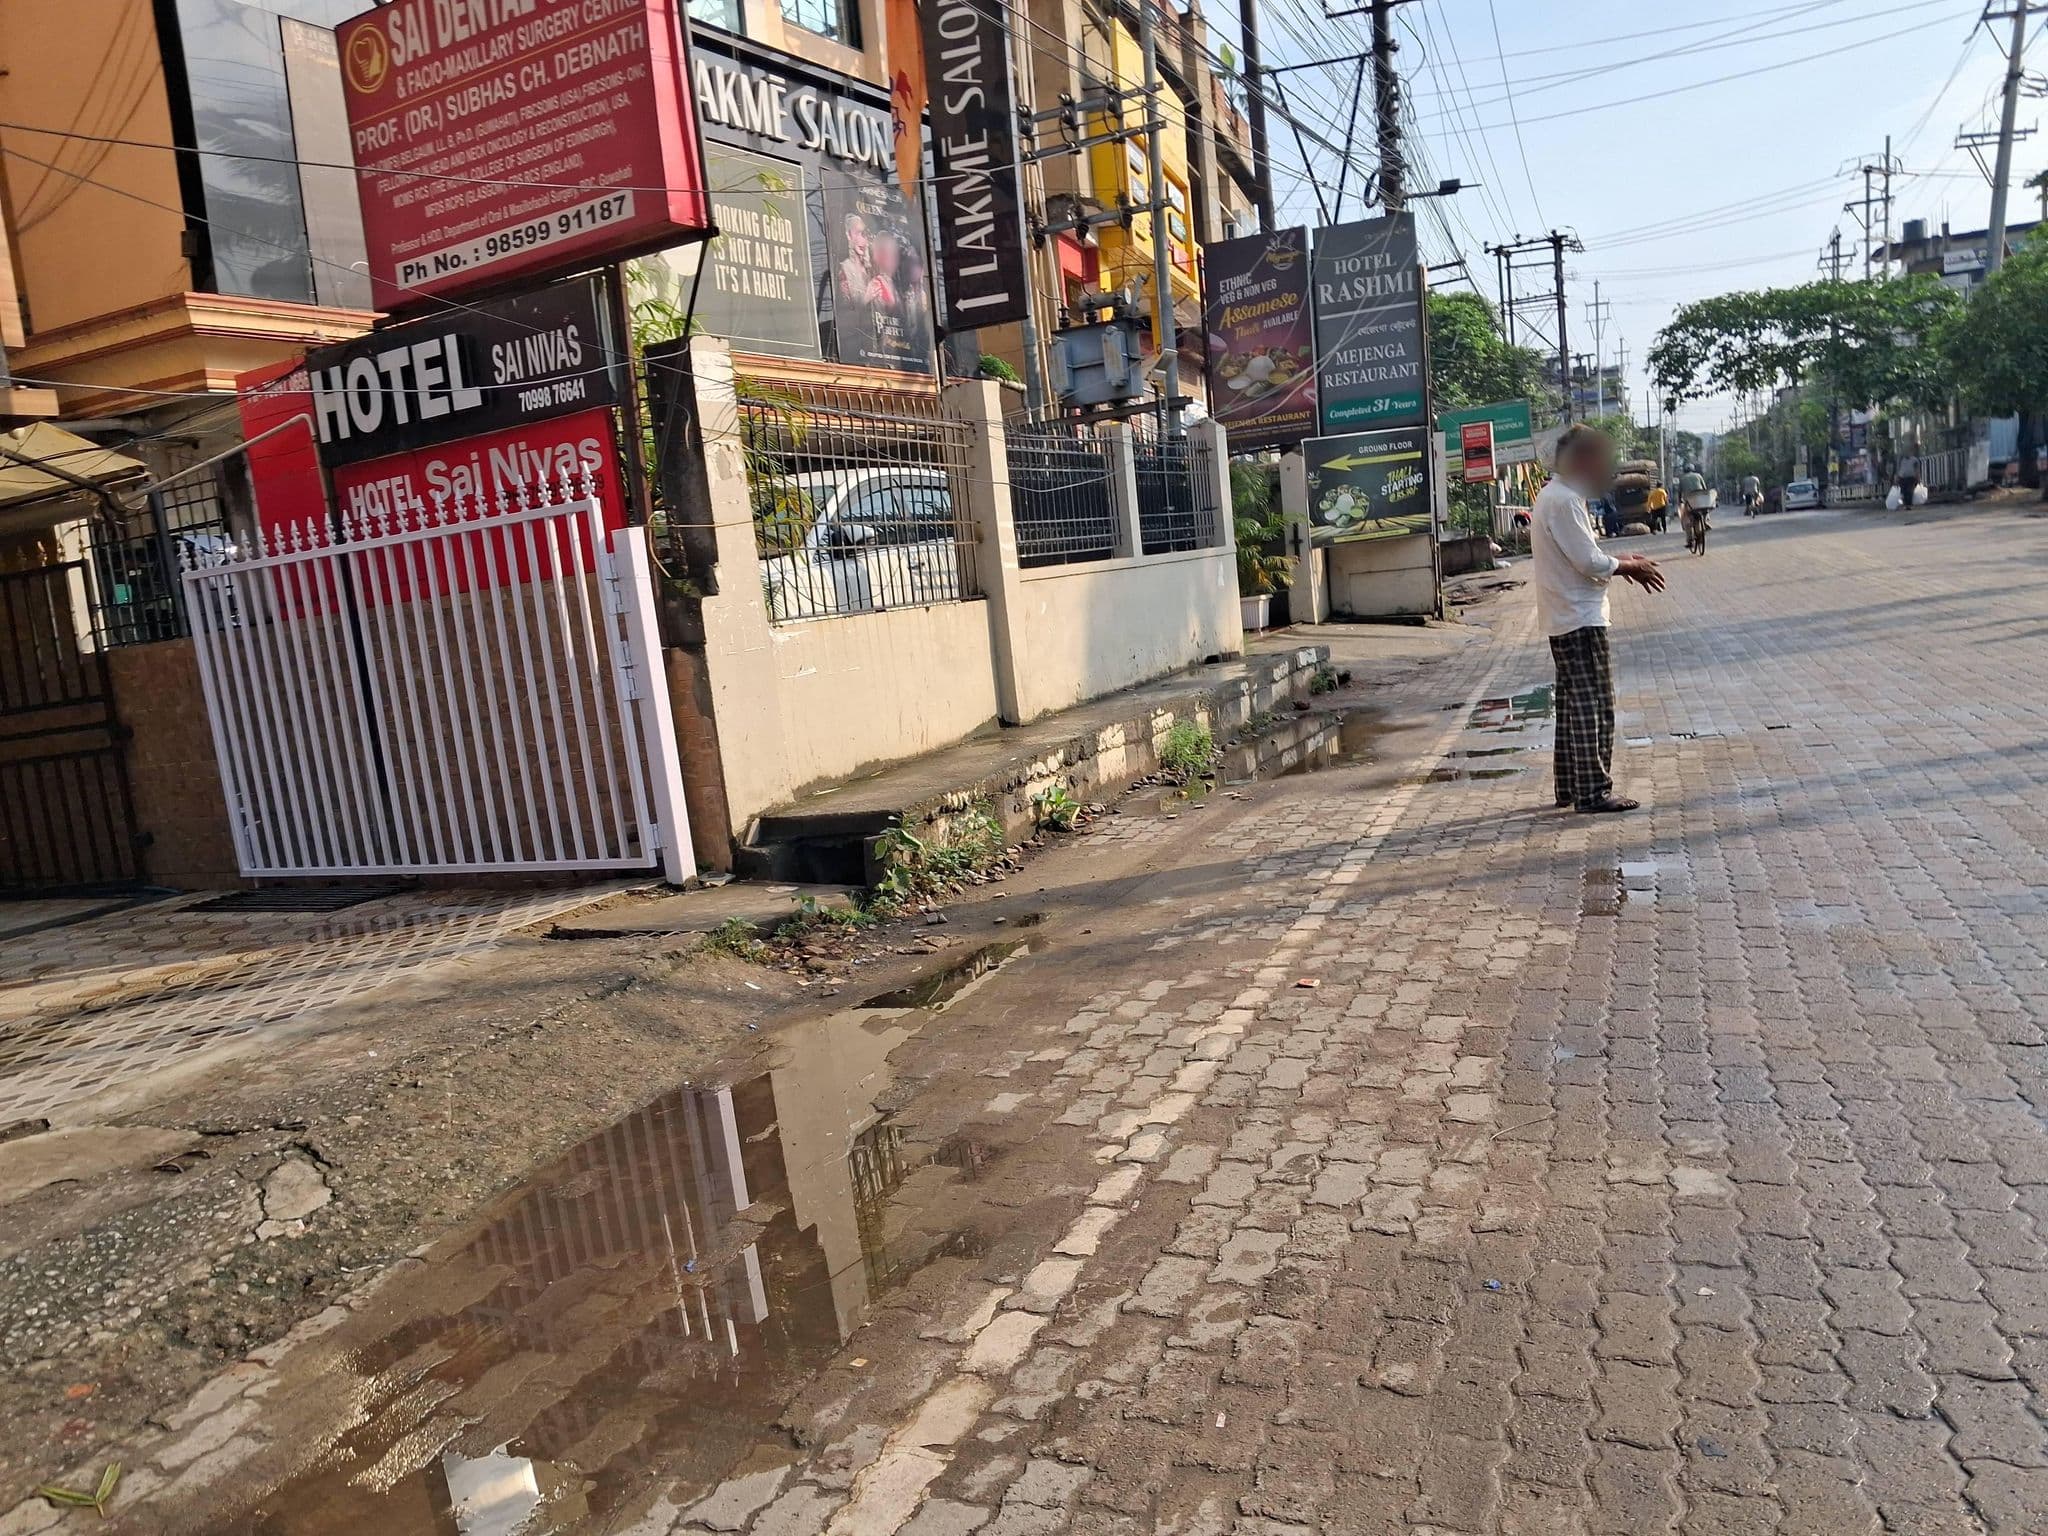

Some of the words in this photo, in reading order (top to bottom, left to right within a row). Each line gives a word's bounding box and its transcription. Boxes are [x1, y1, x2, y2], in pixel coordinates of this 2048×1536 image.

[388, 0, 430, 66] SAI
[396, 76, 407, 98] &
[407, 30, 514, 95] FACIO-MAXILLARY
[517, 4, 579, 50] SURGERY
[356, 114, 402, 154] PROF.
[403, 98, 444, 143] (DR.)
[445, 70, 517, 121] SUBHAS
[518, 57, 551, 93] CH.
[554, 21, 645, 80] DEBNATH
[800, 94, 890, 169] SALON
[429, 156, 449, 176] HEAD
[449, 150, 465, 168] AND
[465, 143, 486, 163] NECK
[485, 127, 528, 155] ONCOLOGY
[468, 157, 504, 183] COLLEGE
[504, 153, 517, 170] OF
[516, 140, 553, 166] SURGEON
[553, 136, 565, 153] OF
[402, 259, 427, 284] Ph
[433, 246, 467, 274] No.
[472, 242, 480, 261] :
[485, 219, 550, 257] 98599
[557, 195, 627, 235] 91187
[443, 215, 480, 238] Department
[762, 214, 793, 244] GOOD
[714, 236, 725, 261] IS
[728, 237, 751, 264] NOT
[755, 242, 771, 268] AN
[1334, 253, 1397, 275] HOTEL
[715, 264, 739, 293] IT'S
[742, 269, 751, 295] A
[753, 271, 792, 300] HABIT.
[1220, 272, 1252, 293] ETHNIC
[1220, 292, 1236, 305] VEG
[1237, 290, 1242, 300] &
[1244, 284, 1260, 298] NON
[1261, 278, 1277, 292] VEG
[1318, 271, 1414, 304] RASHMI
[1219, 293, 1299, 331] Assamese
[1263, 310, 1299, 329] AVAILABLE
[492, 340, 525, 384] SAI
[525, 325, 582, 376] NIVAS
[1336, 342, 1406, 367] MEJENGA
[310, 333, 482, 443] HOTEL
[1324, 362, 1419, 388] RESTAURANT
[518, 387, 551, 412] 70998
[552, 378, 586, 404] 76641
[1330, 405, 1372, 419] Completed
[1373, 398, 1391, 412] 31
[1392, 400, 1417, 410] Years
[1258, 411, 1311, 425] RESTAURANT
[1359, 444, 1388, 454] GROUND
[1389, 441, 1413, 450] FLOOR
[348, 474, 420, 520] HOTEL
[425, 451, 483, 502] Sai
[489, 437, 604, 490] Nivas
[1381, 473, 1423, 496] STARTING
[1387, 465, 1412, 484] THALI
